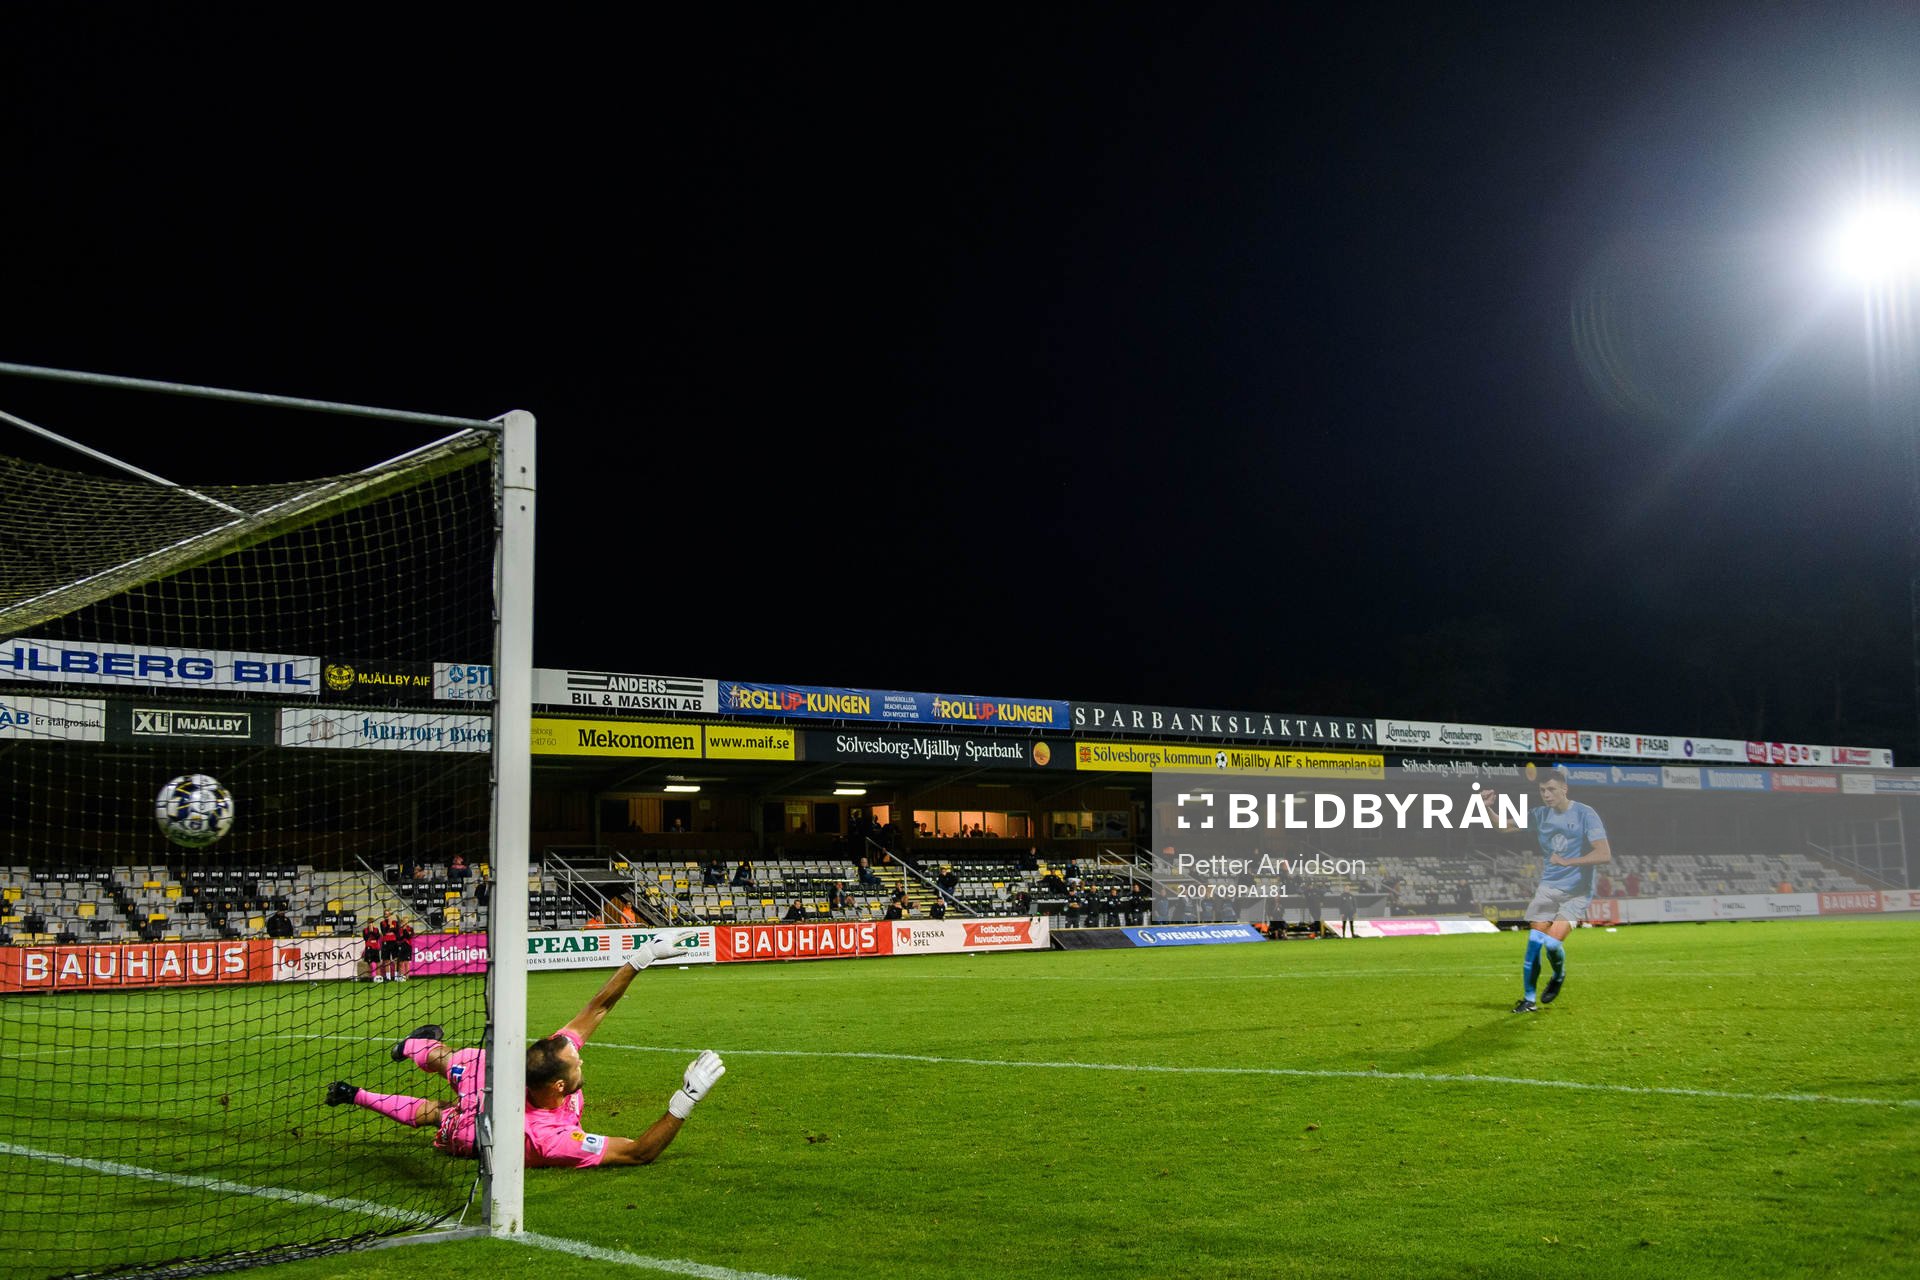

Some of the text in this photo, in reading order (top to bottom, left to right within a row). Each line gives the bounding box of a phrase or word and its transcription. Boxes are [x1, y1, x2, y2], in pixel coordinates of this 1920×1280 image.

[234, 660, 312, 686] BIL
[358, 672, 411, 686] MJÄLLBY
[413, 675, 431, 687] AIF
[608, 676, 667, 694] ANDERS
[571, 692, 702, 711] BIL & MASKIN AB
[739, 689, 870, 715] ROLLUP-KUNGEN
[35, 716, 44, 725] Er
[941, 700, 1053, 723] ROLLUP-KUNGEN
[177, 715, 242, 731] MJÄLLBY
[1075, 706, 1374, 740] SPARBANKSLÄKTAREN
[1386, 722, 1431, 742] Lönneberga
[578, 728, 695, 750] Mekonomen
[710, 735, 790, 750] www.maif.se
[1439, 724, 1482, 744] Lönneberga
[1535, 730, 1577, 753] SAVE
[1603, 735, 1631, 749] FASAB
[836, 734, 1023, 761] Sölvesborg-Mjällby Sparbank
[1643, 738, 1669, 752] FASAB
[1093, 746, 1212, 767] Sölvesborgs kommun
[1231, 753, 1271, 771] Mjällby
[1305, 756, 1367, 773] hemmaplan
[1482, 762, 1520, 778] Sparbank
[1823, 894, 1876, 909] BAUHAUS
[913, 930, 945, 939] SVENSKA
[980, 924, 1015, 934] Fotbollens
[1157, 928, 1251, 941] SVENSKA CUPEN
[527, 935, 600, 954] PEAB
[735, 927, 875, 953] BAUHAUS
[913, 939, 930, 947] SPEL
[304, 951, 352, 961] SVENSKA
[414, 946, 487, 963] backlinjen
[26, 947, 245, 981] BAUHAUS
[304, 961, 327, 971] SPEL
